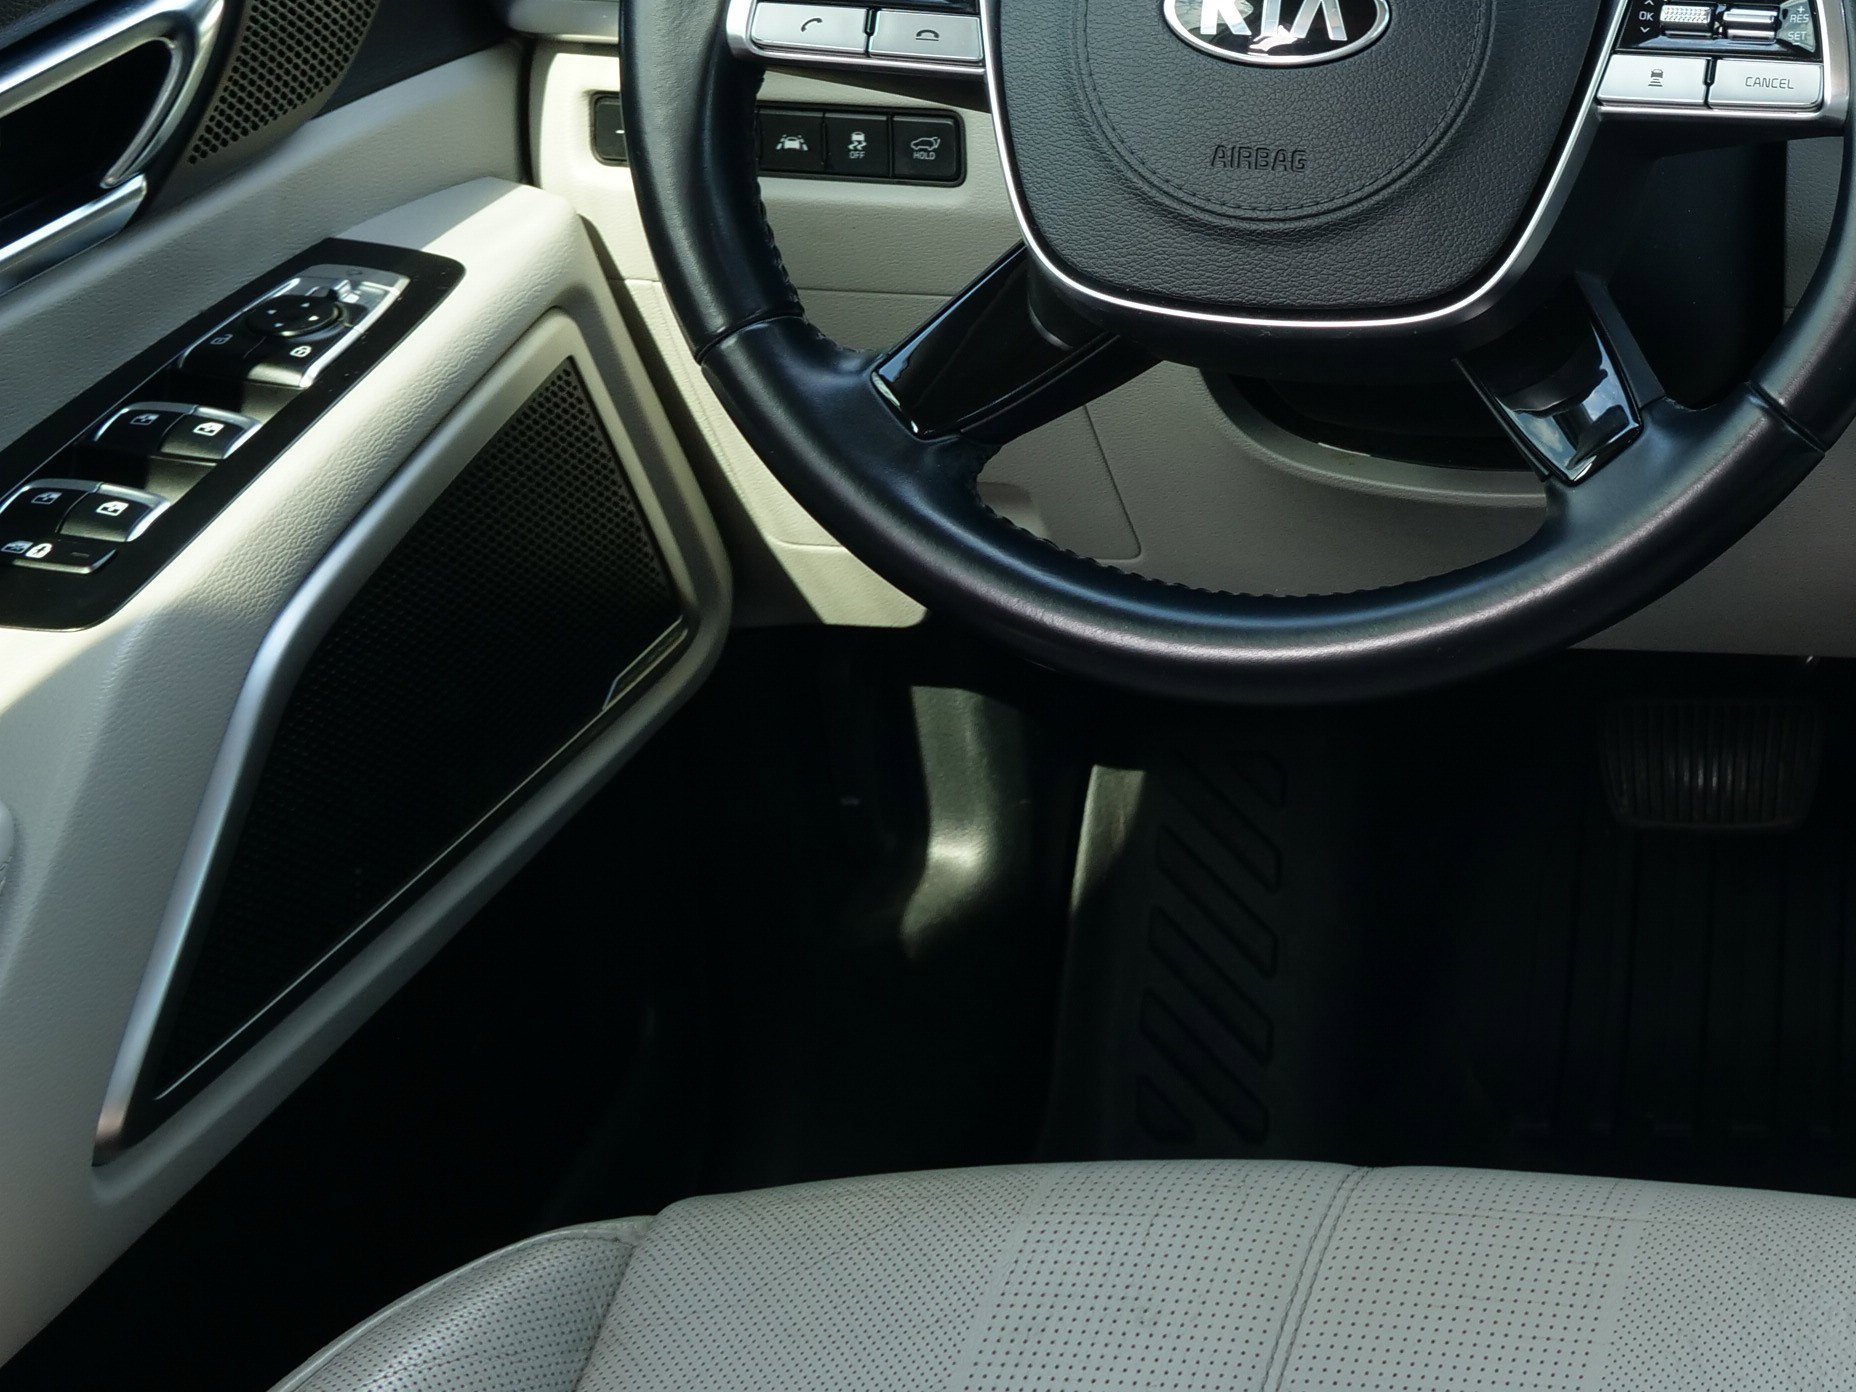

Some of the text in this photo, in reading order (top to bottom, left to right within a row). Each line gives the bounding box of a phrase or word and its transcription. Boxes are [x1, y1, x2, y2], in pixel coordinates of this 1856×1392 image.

[1638, 10, 1655, 22] OK
[1789, 13, 1810, 24] RES
[1788, 30, 1807, 41] SET
[1745, 76, 1795, 90] CANCEL
[849, 150, 866, 160] OFF
[912, 150, 936, 161] HOLD
[1211, 144, 1308, 173] AIRBAG
